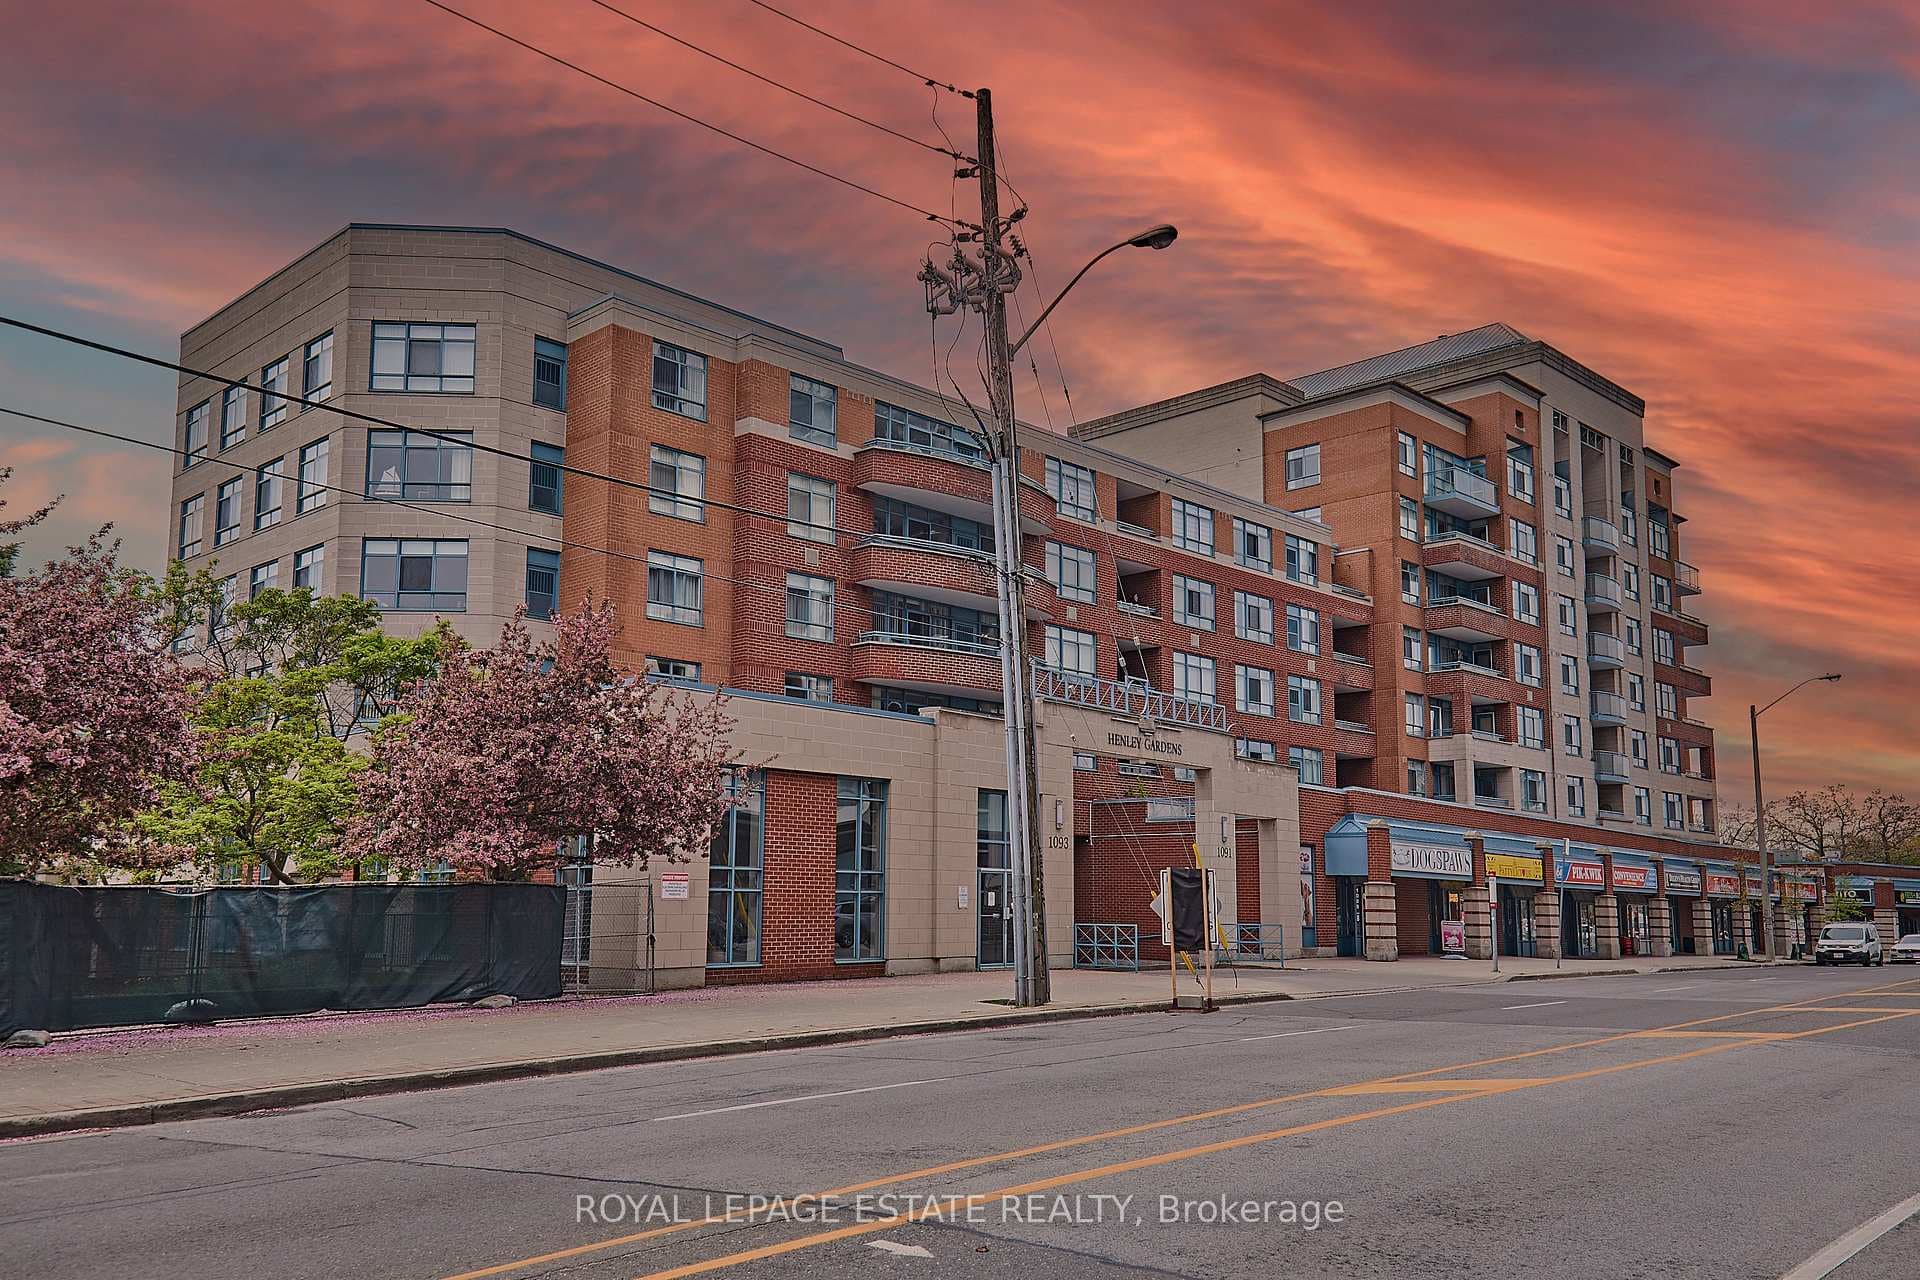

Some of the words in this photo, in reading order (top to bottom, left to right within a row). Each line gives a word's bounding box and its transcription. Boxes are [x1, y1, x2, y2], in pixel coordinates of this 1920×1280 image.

[1108, 732, 1142, 749] HENLEY
[1144, 738, 1182, 756] GARDENS
[1048, 836, 1069, 849] 1093
[1217, 846, 1232, 859] 1091
[1411, 848, 1471, 873] DOGSPAWS
[1614, 870, 1645, 882] CONVENIENCE
